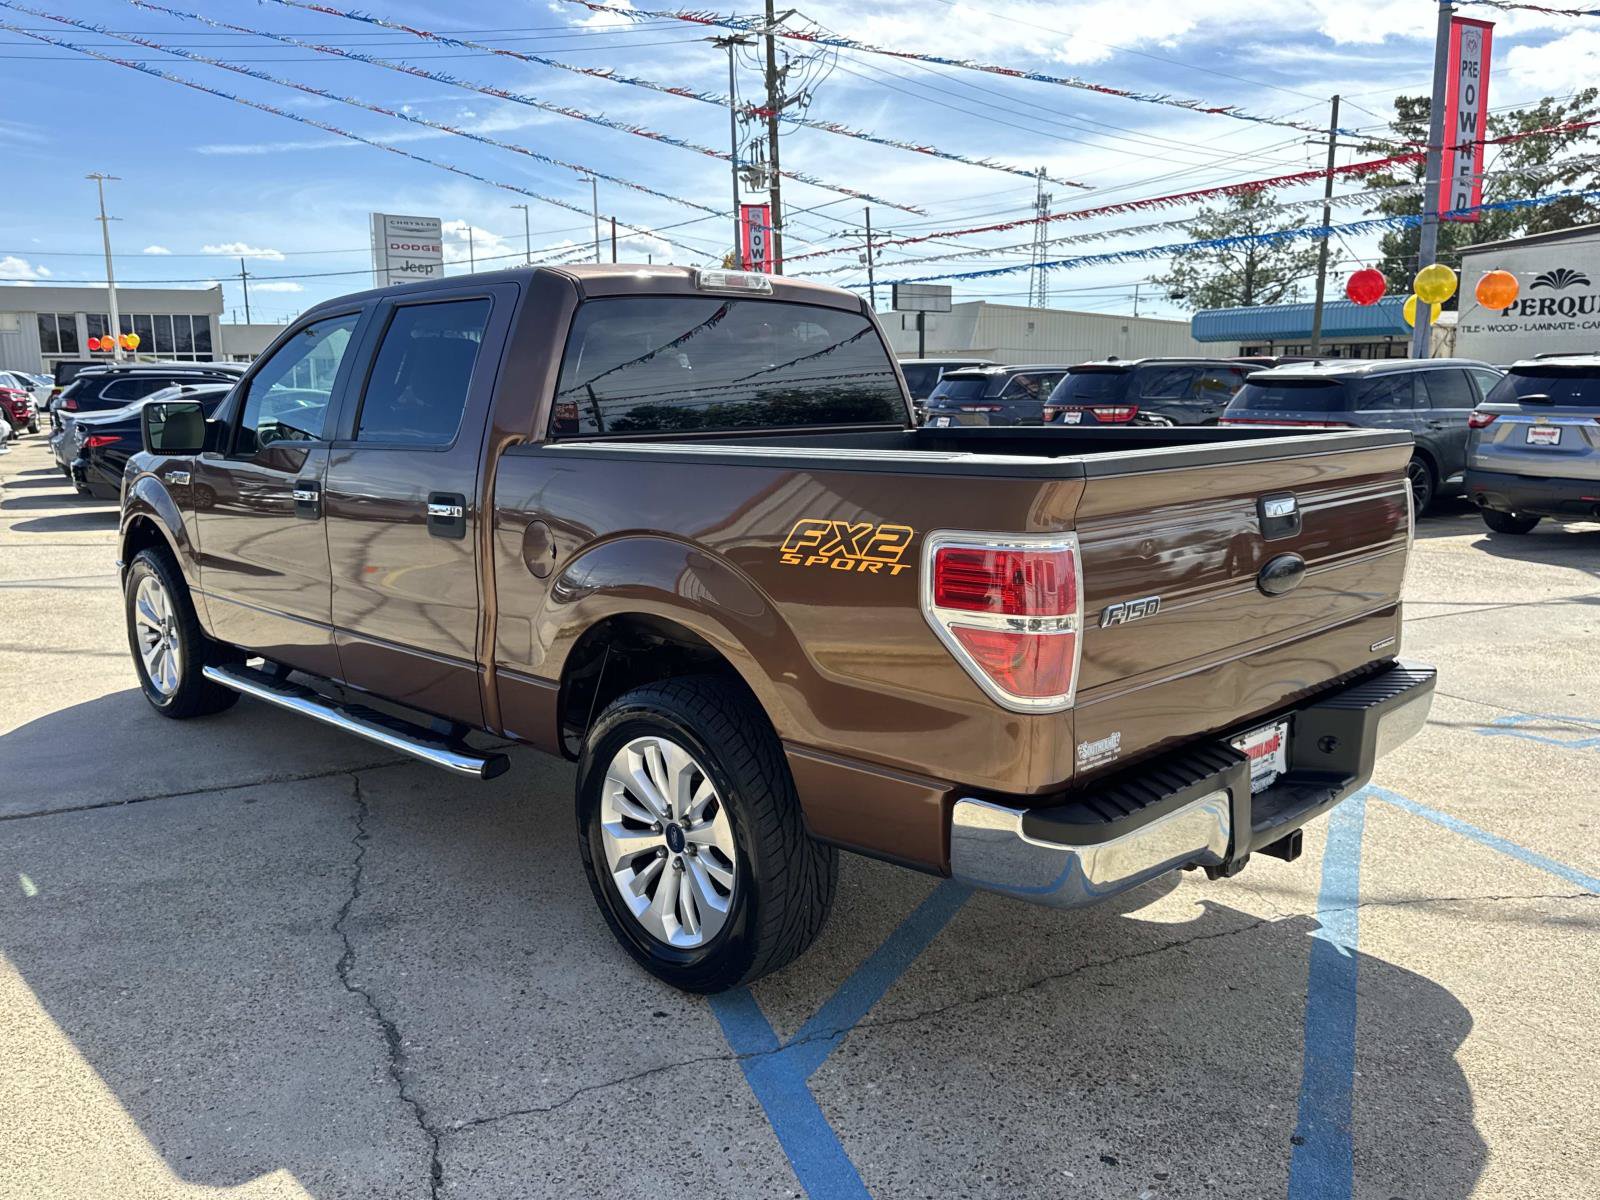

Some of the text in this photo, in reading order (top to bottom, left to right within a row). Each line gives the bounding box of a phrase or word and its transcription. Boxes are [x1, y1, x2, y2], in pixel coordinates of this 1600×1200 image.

[390, 242, 441, 253] DODGE
[400, 260, 434, 275] Jeep
[1501, 295, 1600, 318] PERQU
[1461, 325, 1480, 333] TILE
[1487, 323, 1518, 333] WOOD
[1524, 321, 1575, 332] LAMINATE
[780, 518, 914, 563] FX2
[779, 553, 911, 576] SPORT
